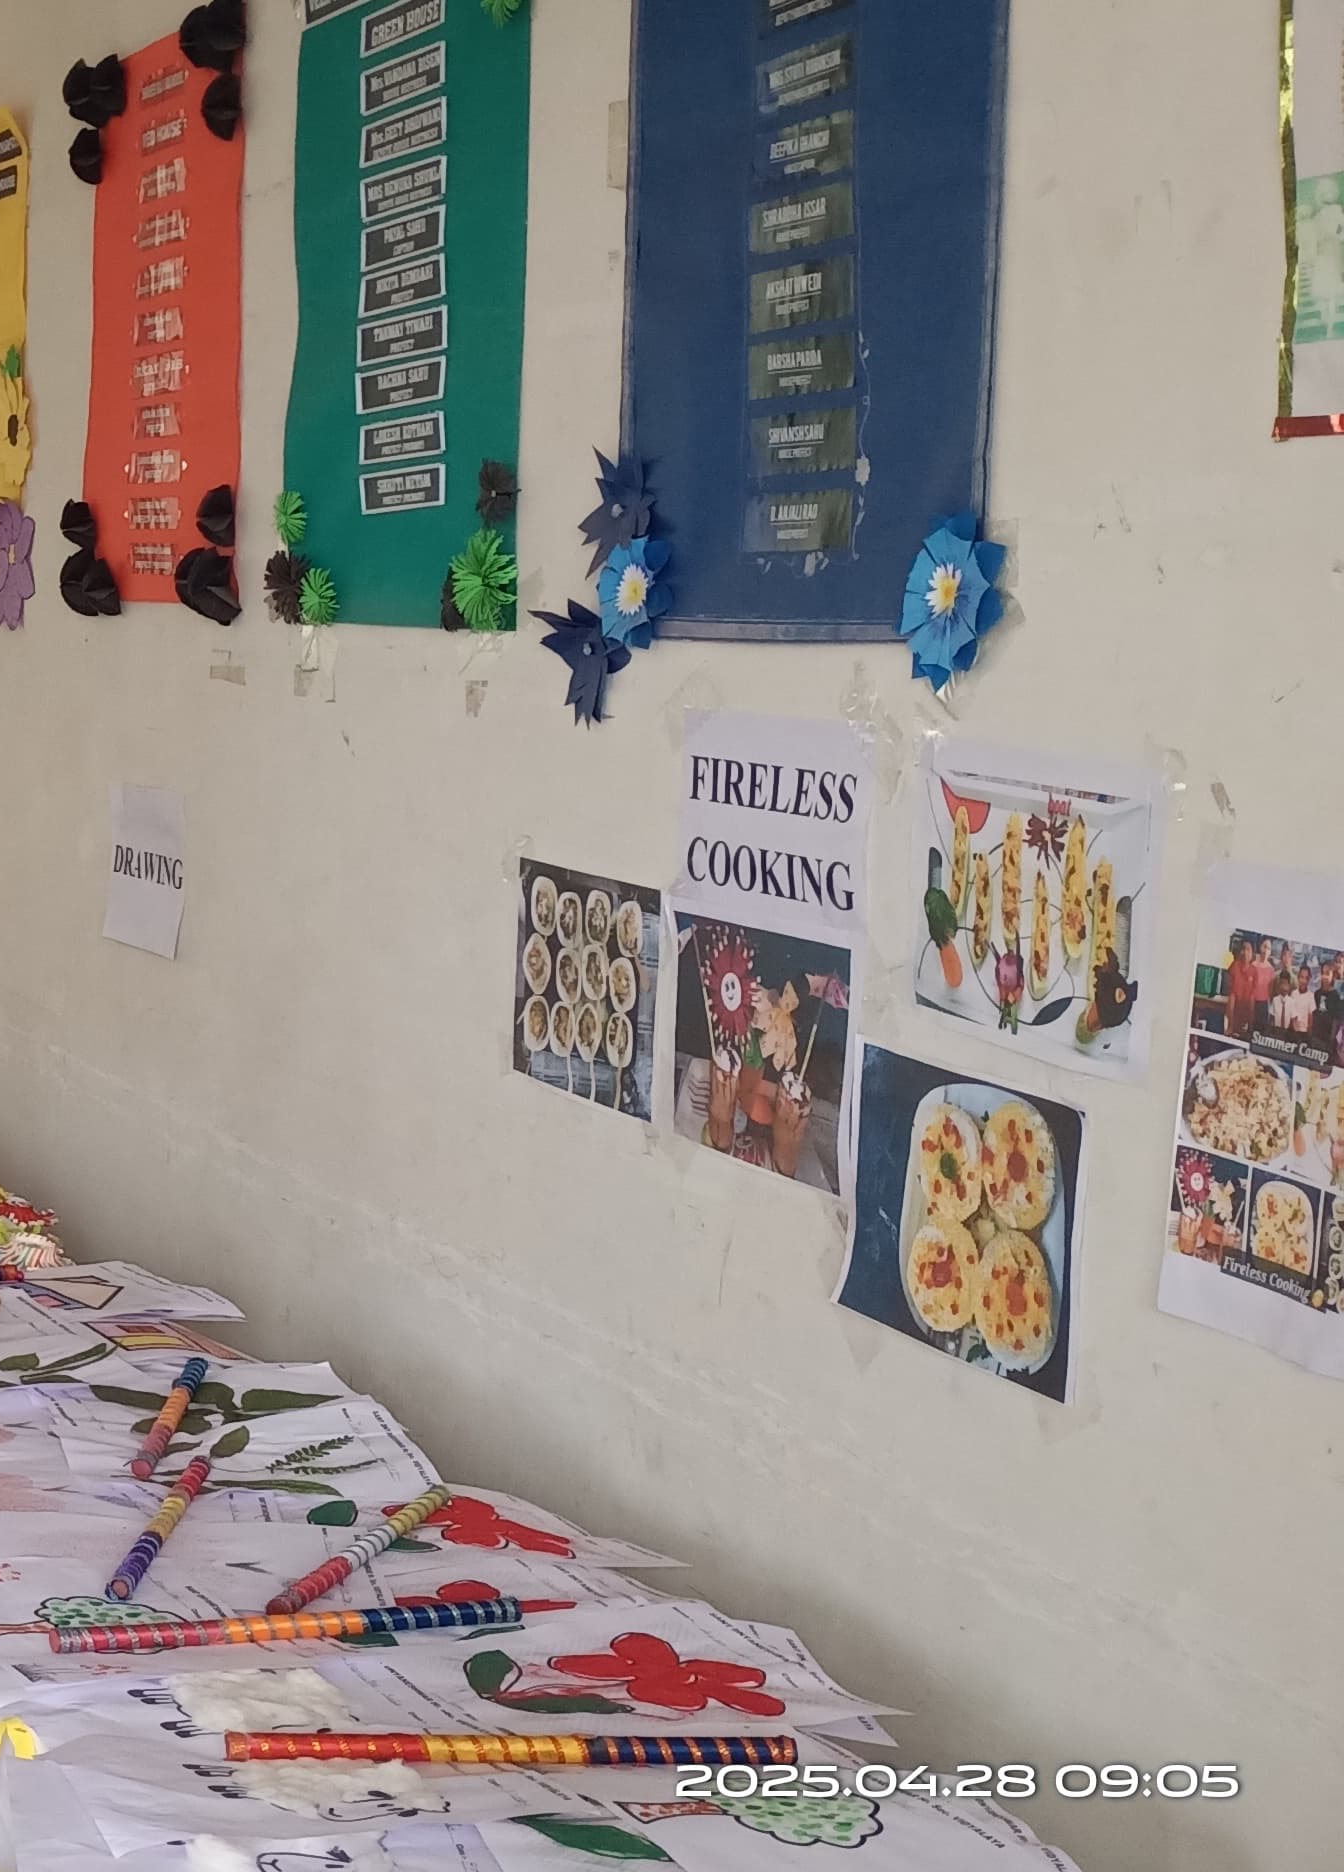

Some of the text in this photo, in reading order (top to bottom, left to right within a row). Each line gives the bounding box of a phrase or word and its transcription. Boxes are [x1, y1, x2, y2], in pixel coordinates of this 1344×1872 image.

[371, 2, 440, 47] GREEN HOUSE
[689, 755, 858, 824] FIRELESS
[113, 845, 183, 889] DRAWING
[687, 836, 855, 911] COOKING
[1252, 1031, 1329, 1066] Summer Camp
[1223, 1256, 1311, 1304] Fireless Cooking
